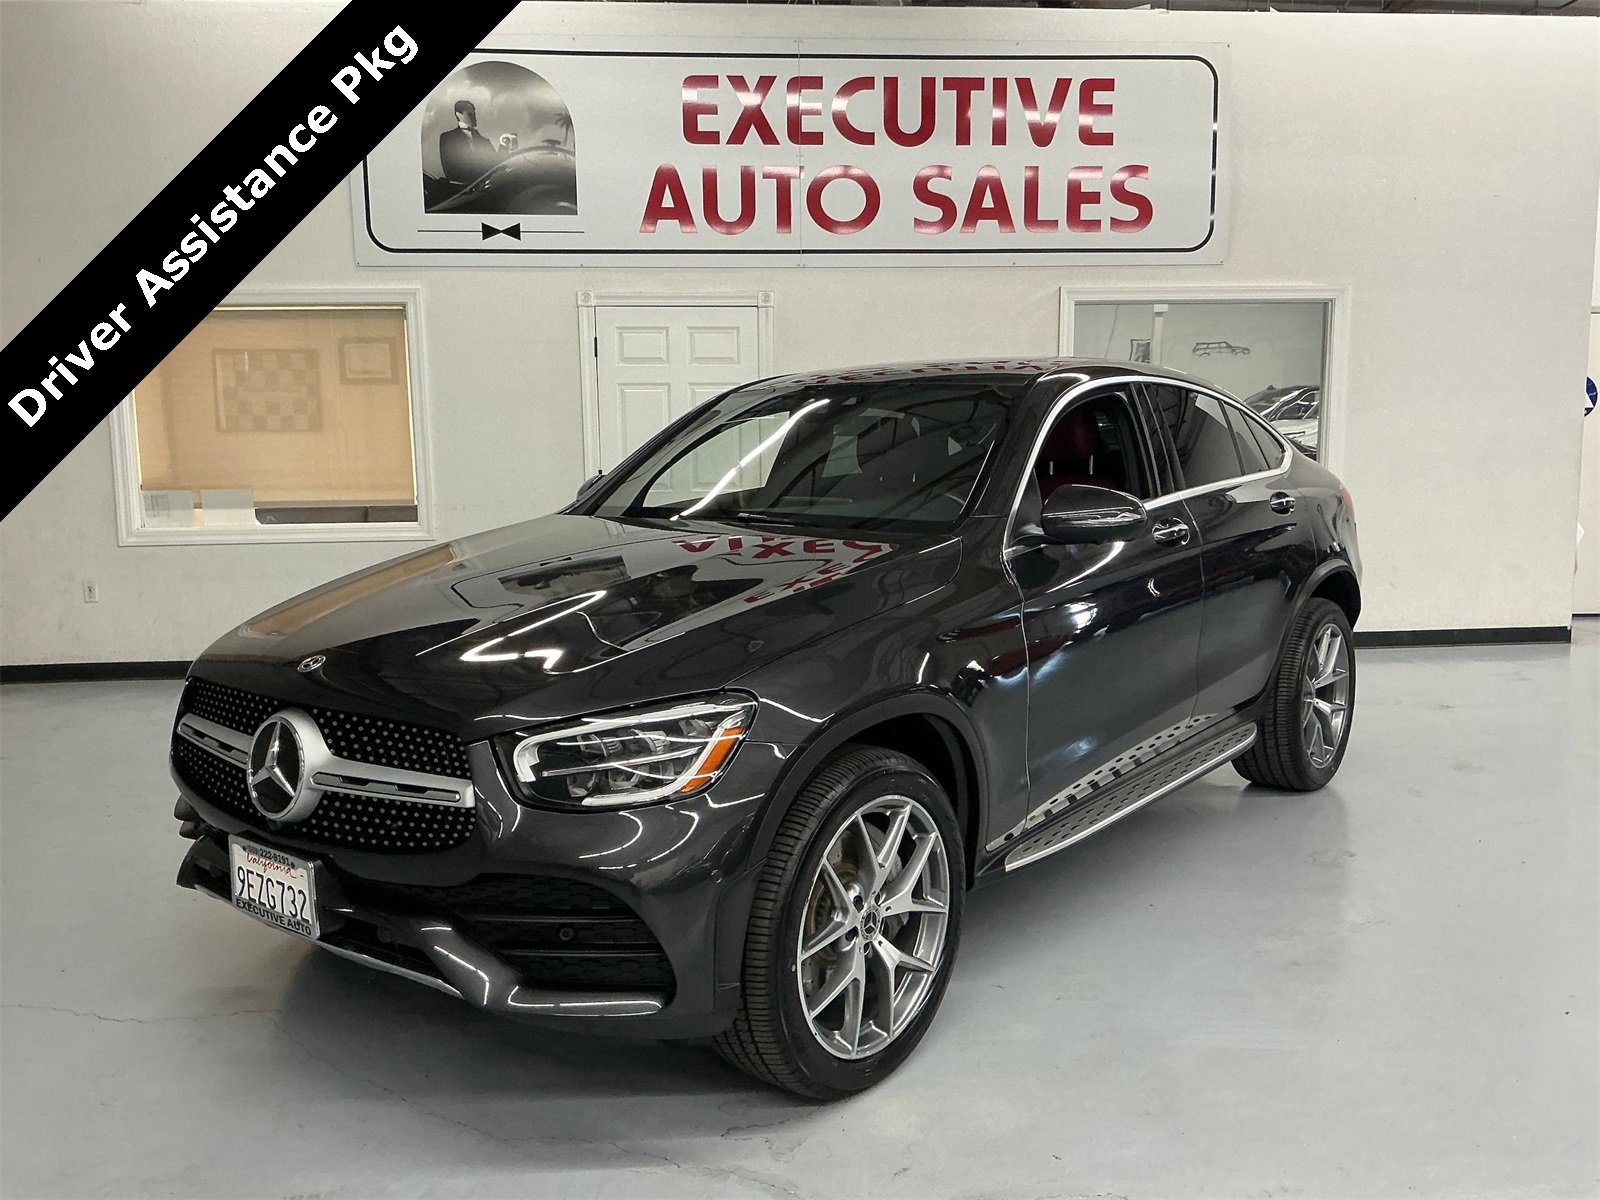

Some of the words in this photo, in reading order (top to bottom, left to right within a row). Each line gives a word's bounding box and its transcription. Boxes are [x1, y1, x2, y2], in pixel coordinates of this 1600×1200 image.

[682, 74, 1116, 148] EXECUTIVE
[639, 164, 881, 235] AUTO
[912, 164, 1154, 235] SALES
[236, 898, 285, 925] EXECUTIVE
[287, 918, 312, 936] AUTO
[237, 866, 310, 924] 9EZG732
